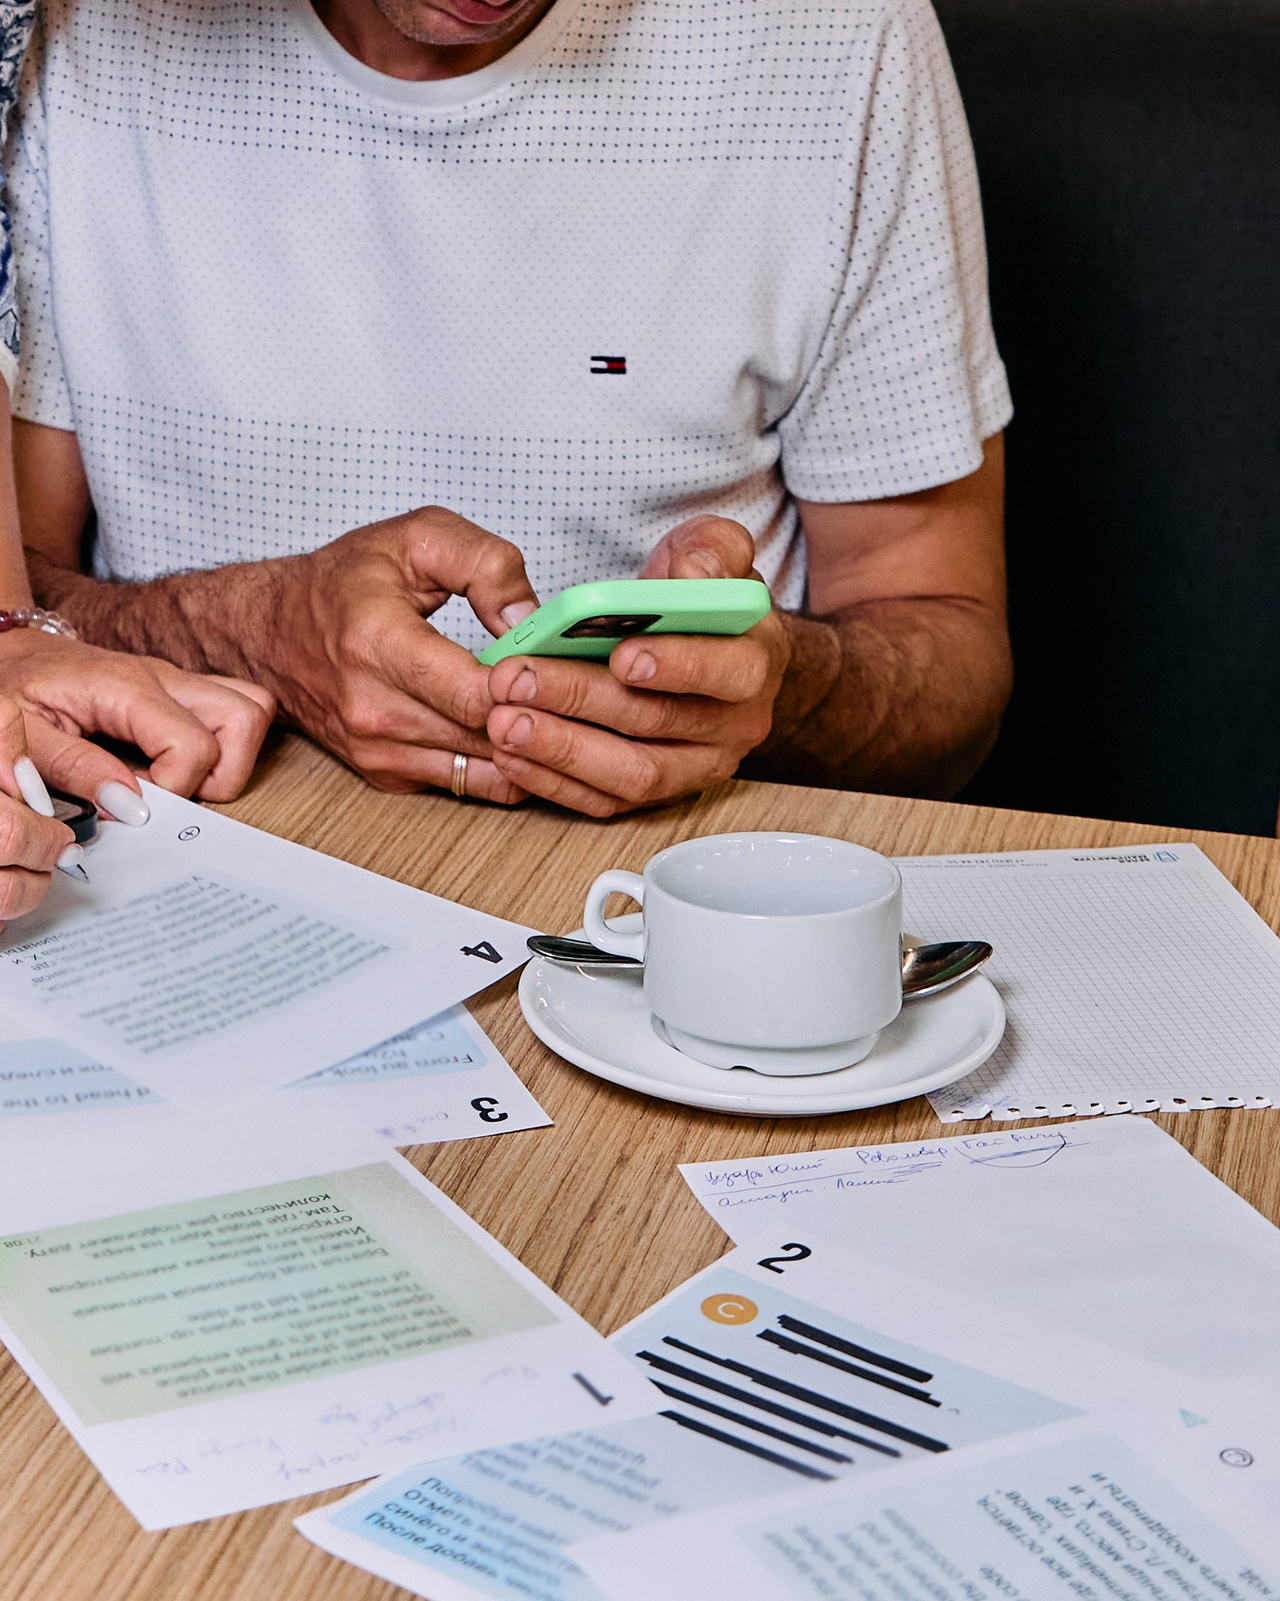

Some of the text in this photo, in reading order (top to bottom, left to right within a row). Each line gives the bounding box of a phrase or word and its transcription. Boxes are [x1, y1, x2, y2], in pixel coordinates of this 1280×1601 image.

[460, 939, 503, 965] 4
[415, 1053, 473, 1066] From
[2, 1097, 39, 1108] the
[44, 1094, 68, 1104] to
[74, 1088, 131, 1103] head
[470, 1095, 509, 1123] 3
[222, 1193, 331, 1218] количество
[299, 1204, 344, 1216] Там,
[266, 1212, 298, 1224] где
[275, 1214, 353, 1235] откроют
[301, 1225, 365, 1243] Имена
[23, 1242, 71, 1258] дату.
[757, 1242, 812, 1275] 2
[403, 1489, 471, 1526] Отметь
[364, 1511, 427, 1544] После
[383, 1502, 450, 1535] синего
